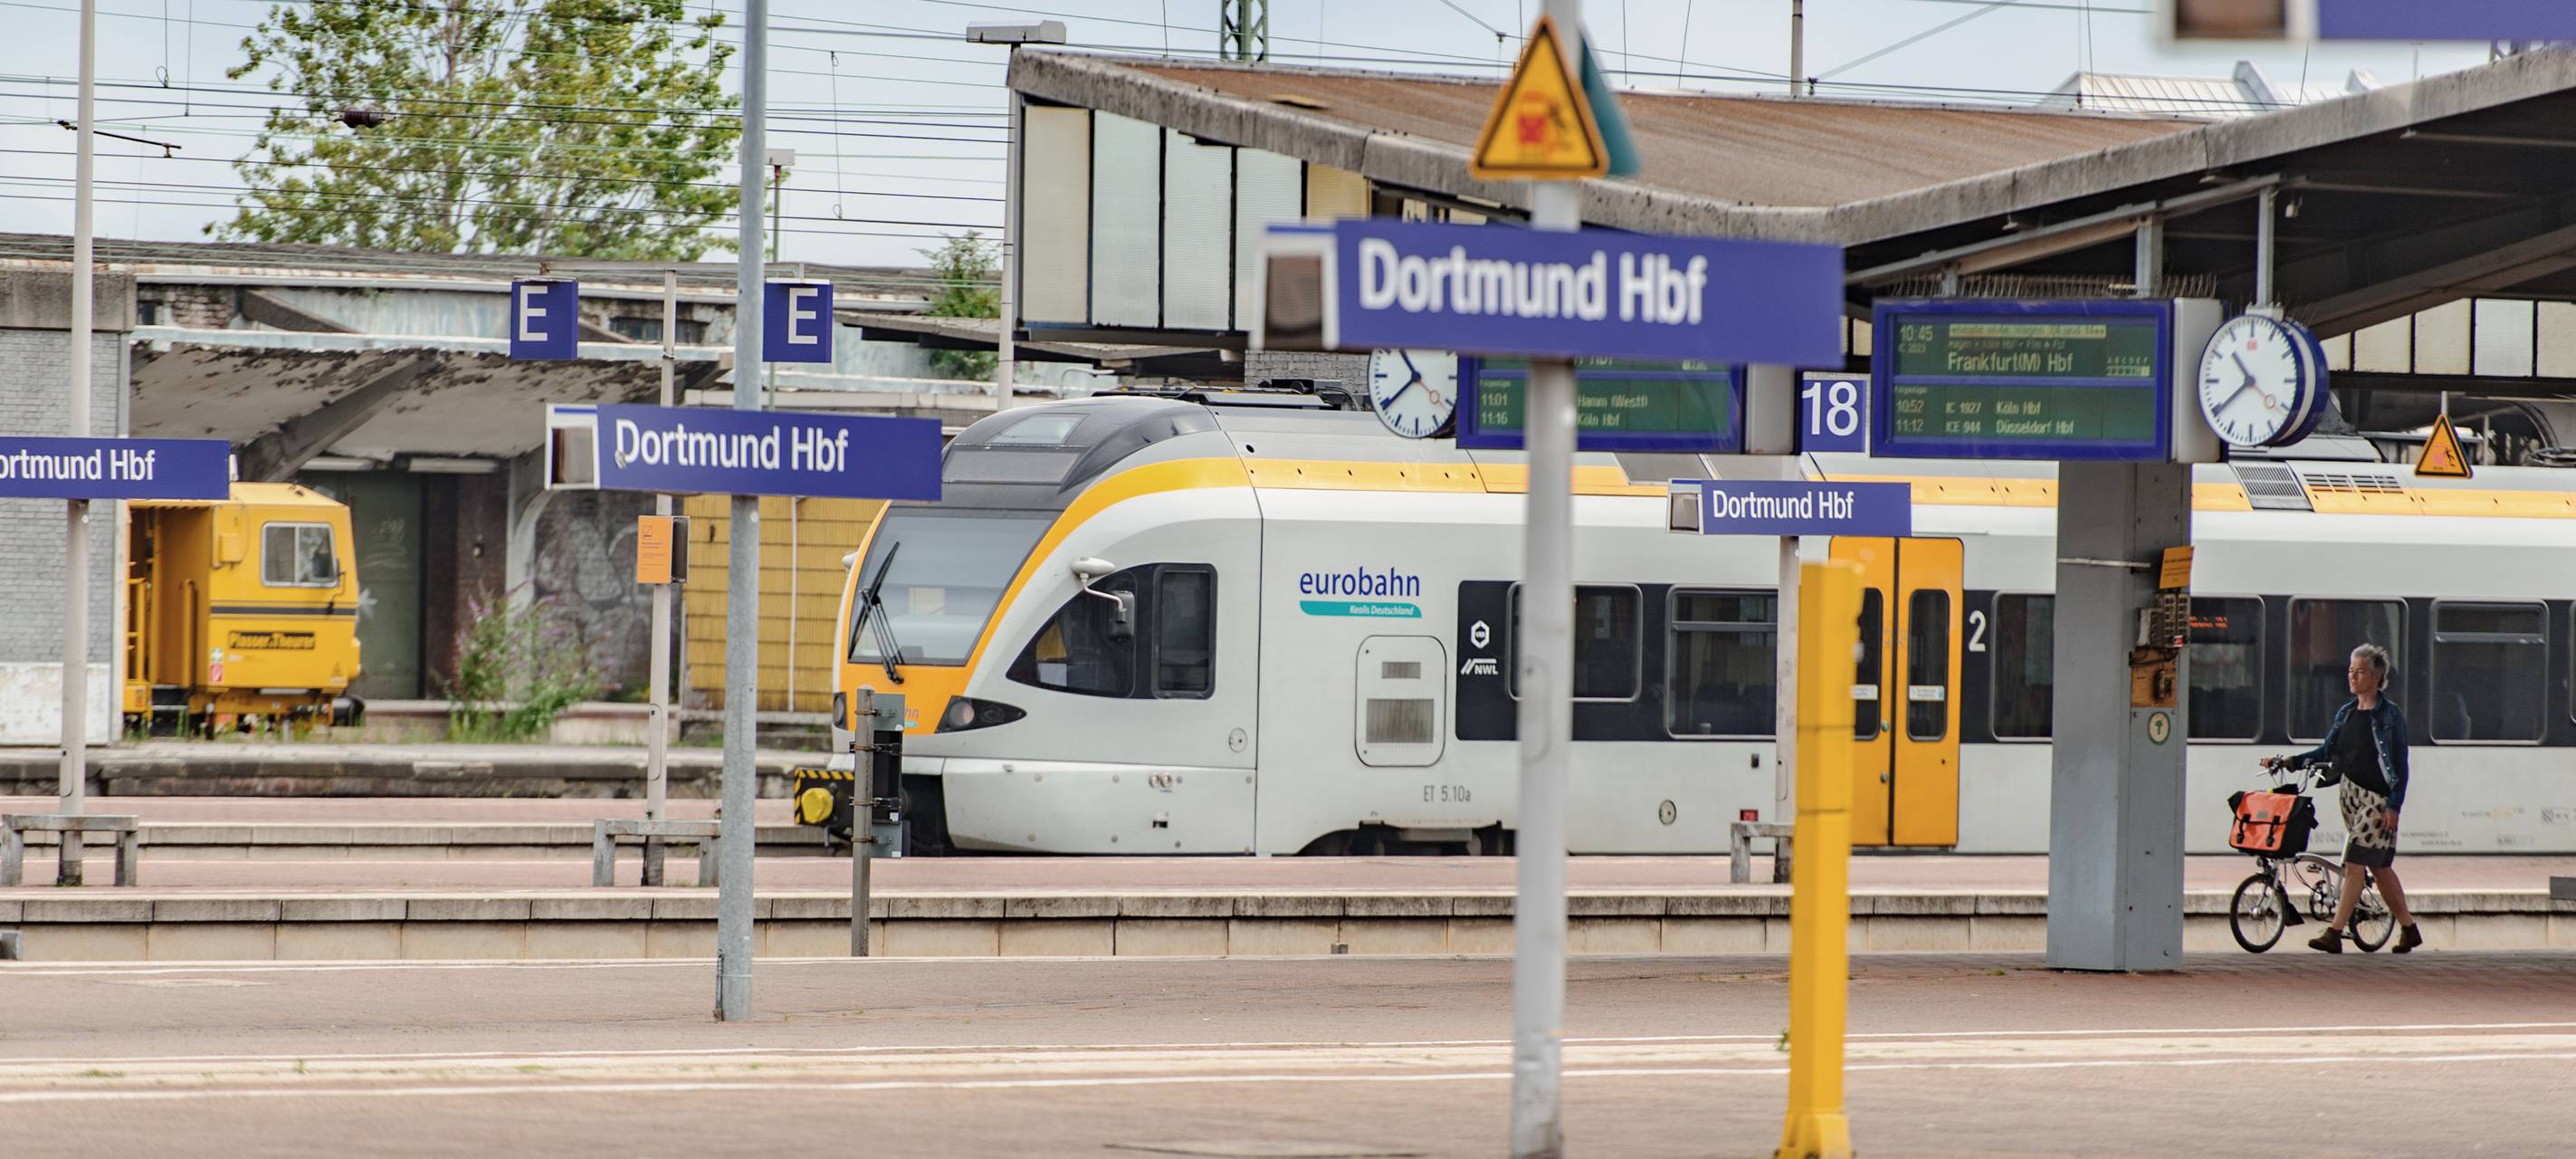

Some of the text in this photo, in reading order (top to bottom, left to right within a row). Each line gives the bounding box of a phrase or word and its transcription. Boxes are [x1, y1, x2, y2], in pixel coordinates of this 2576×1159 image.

[1358, 237, 1708, 325] Dortmund Hbf
[519, 285, 549, 341] E
[787, 287, 818, 345] E
[1899, 325, 1933, 341] 10:45
[1947, 351, 2075, 372] Frankfurt(M) Hbf
[1481, 393, 1508, 407] 11:01
[1578, 395, 1608, 407] Hamm
[1803, 381, 1858, 436] 18
[1996, 399, 2019, 415] Köln
[2022, 400, 2042, 415] Hbf
[1481, 412, 1620, 426] 11:16 Köln Hbf
[1996, 419, 2052, 435] Düsseldorf
[2056, 420, 2075, 435] Hbf
[614, 418, 849, 473] Dortmund Hbf
[0, 448, 156, 481] ortmund Hbf
[1713, 489, 1855, 520] Dortmund Hbf
[1300, 566, 1421, 597] eurobahn
[1349, 605, 1415, 617] Keolis Deutschland
[1969, 609, 1987, 652] 2
[1474, 664, 1499, 676] NWL
[1423, 785, 1472, 803] ET 5.10a
